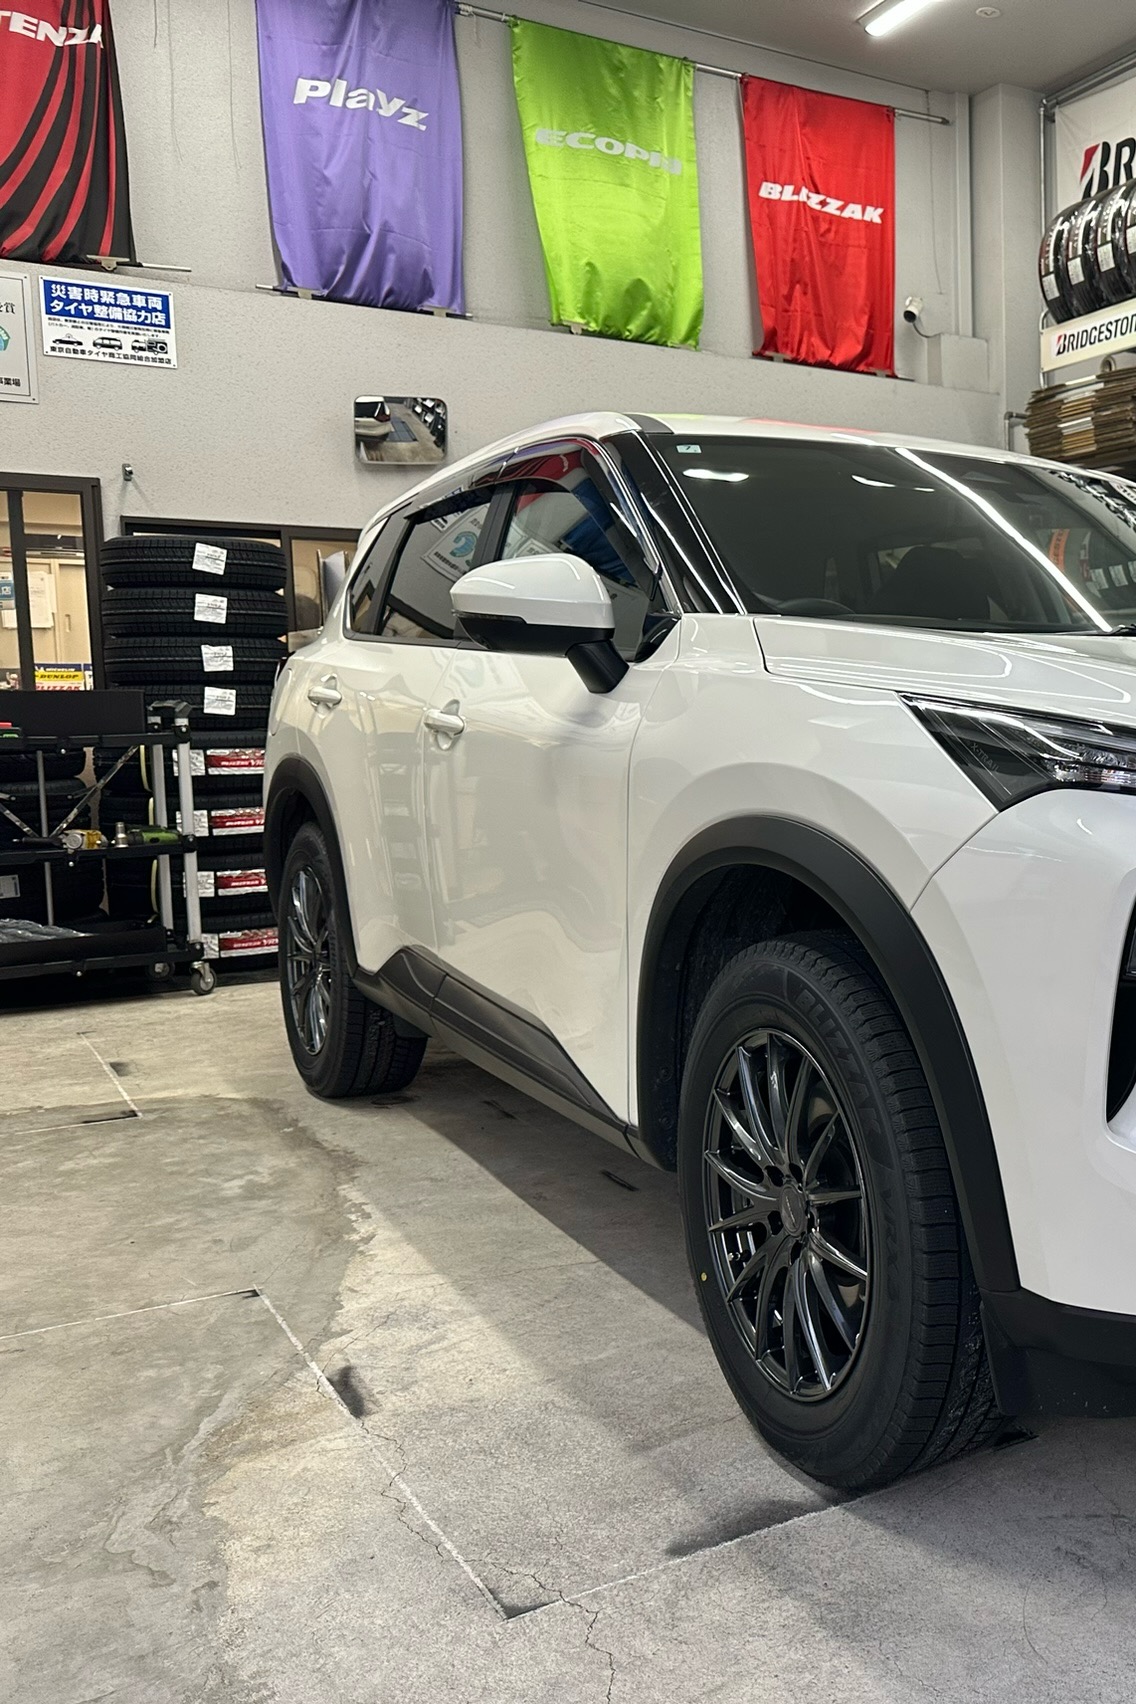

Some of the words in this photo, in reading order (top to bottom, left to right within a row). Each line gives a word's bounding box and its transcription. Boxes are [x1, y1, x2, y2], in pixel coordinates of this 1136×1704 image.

[293, 76, 429, 131] Playz
[51, 283, 162, 311] 災害時緊急車両
[50, 301, 166, 326] タイヤ整備協力店
